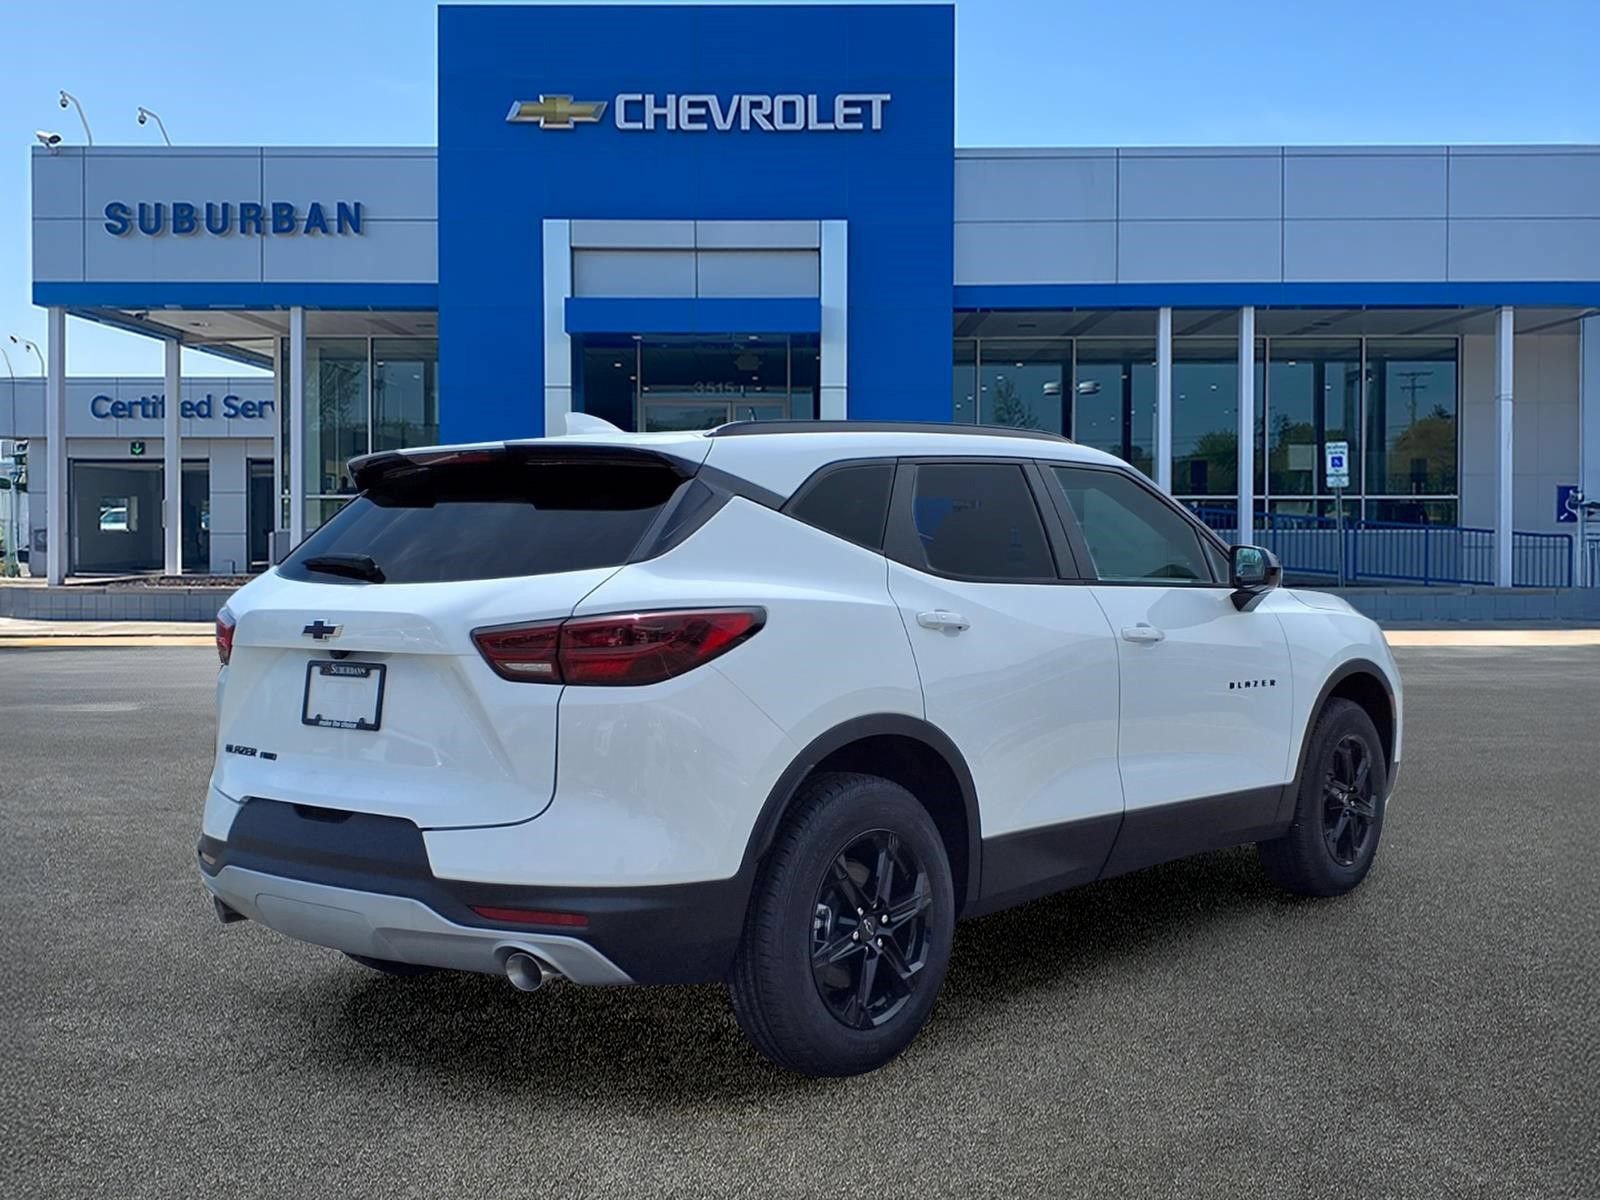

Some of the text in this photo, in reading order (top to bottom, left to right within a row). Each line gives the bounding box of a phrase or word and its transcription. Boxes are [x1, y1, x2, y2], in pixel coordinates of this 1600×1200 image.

[615, 93, 891, 131] CHEVROLET
[104, 202, 361, 235] SUBURBAN
[90, 394, 213, 420] Certifed
[1229, 679, 1276, 689] BLAZER
